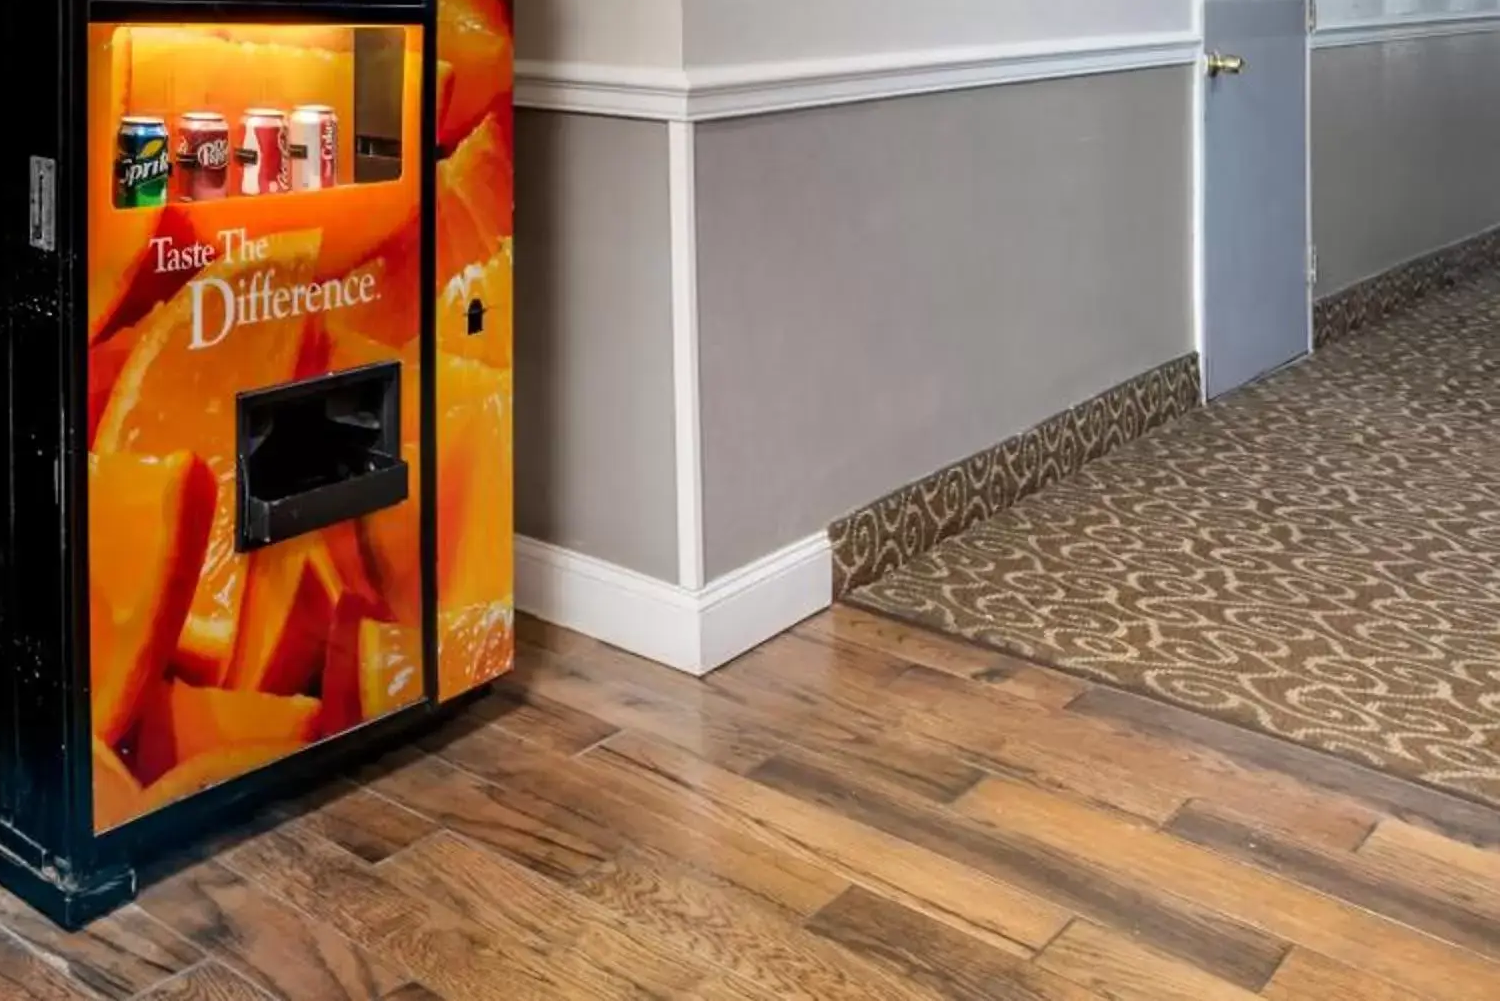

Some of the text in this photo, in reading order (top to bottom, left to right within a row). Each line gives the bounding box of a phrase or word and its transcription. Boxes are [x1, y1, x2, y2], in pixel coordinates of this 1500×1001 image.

[149, 228, 269, 275] Taste The
[187, 266, 382, 352] Difference.
